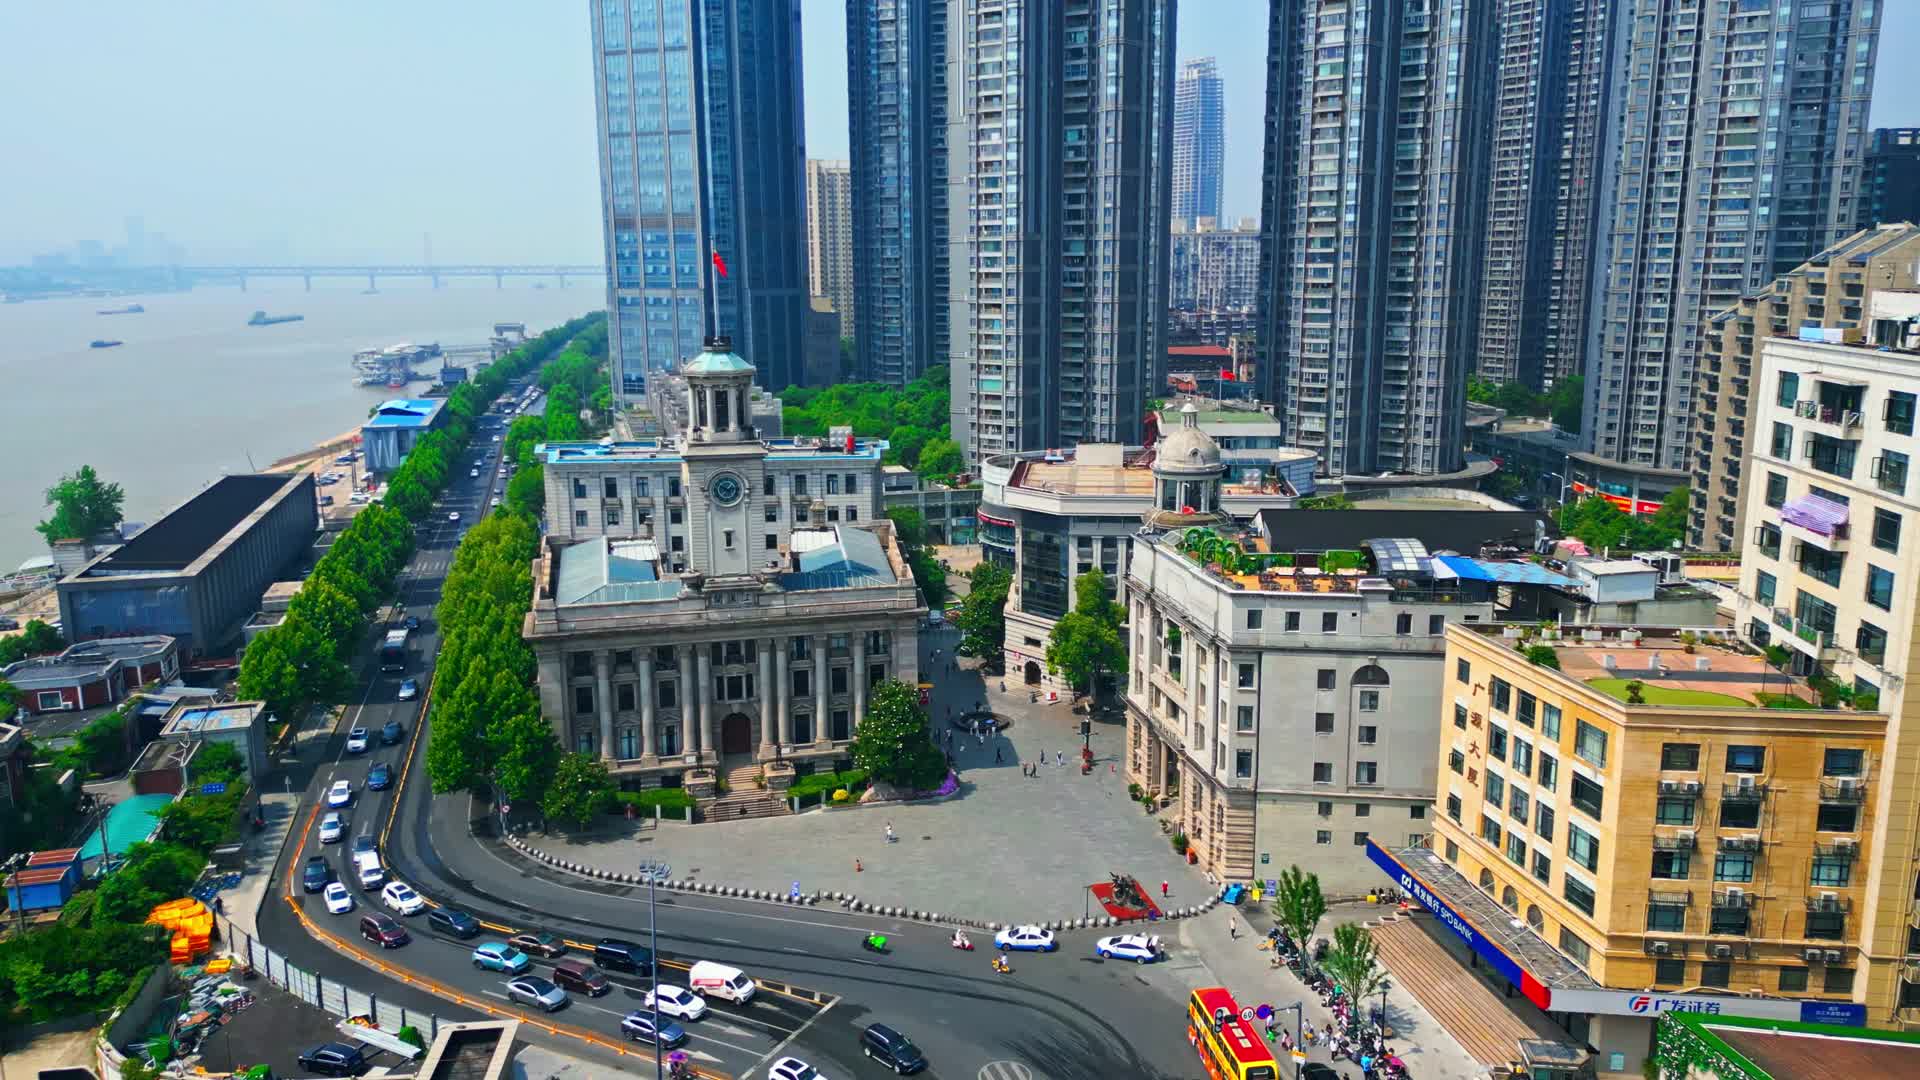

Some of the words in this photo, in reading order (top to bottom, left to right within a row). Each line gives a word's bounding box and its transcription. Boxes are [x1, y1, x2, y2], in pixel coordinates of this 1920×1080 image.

[1453, 920, 1473, 942] BANK
[1243, 1011, 1252, 1019] 60
[1654, 998, 1721, 1015] 广发证券
